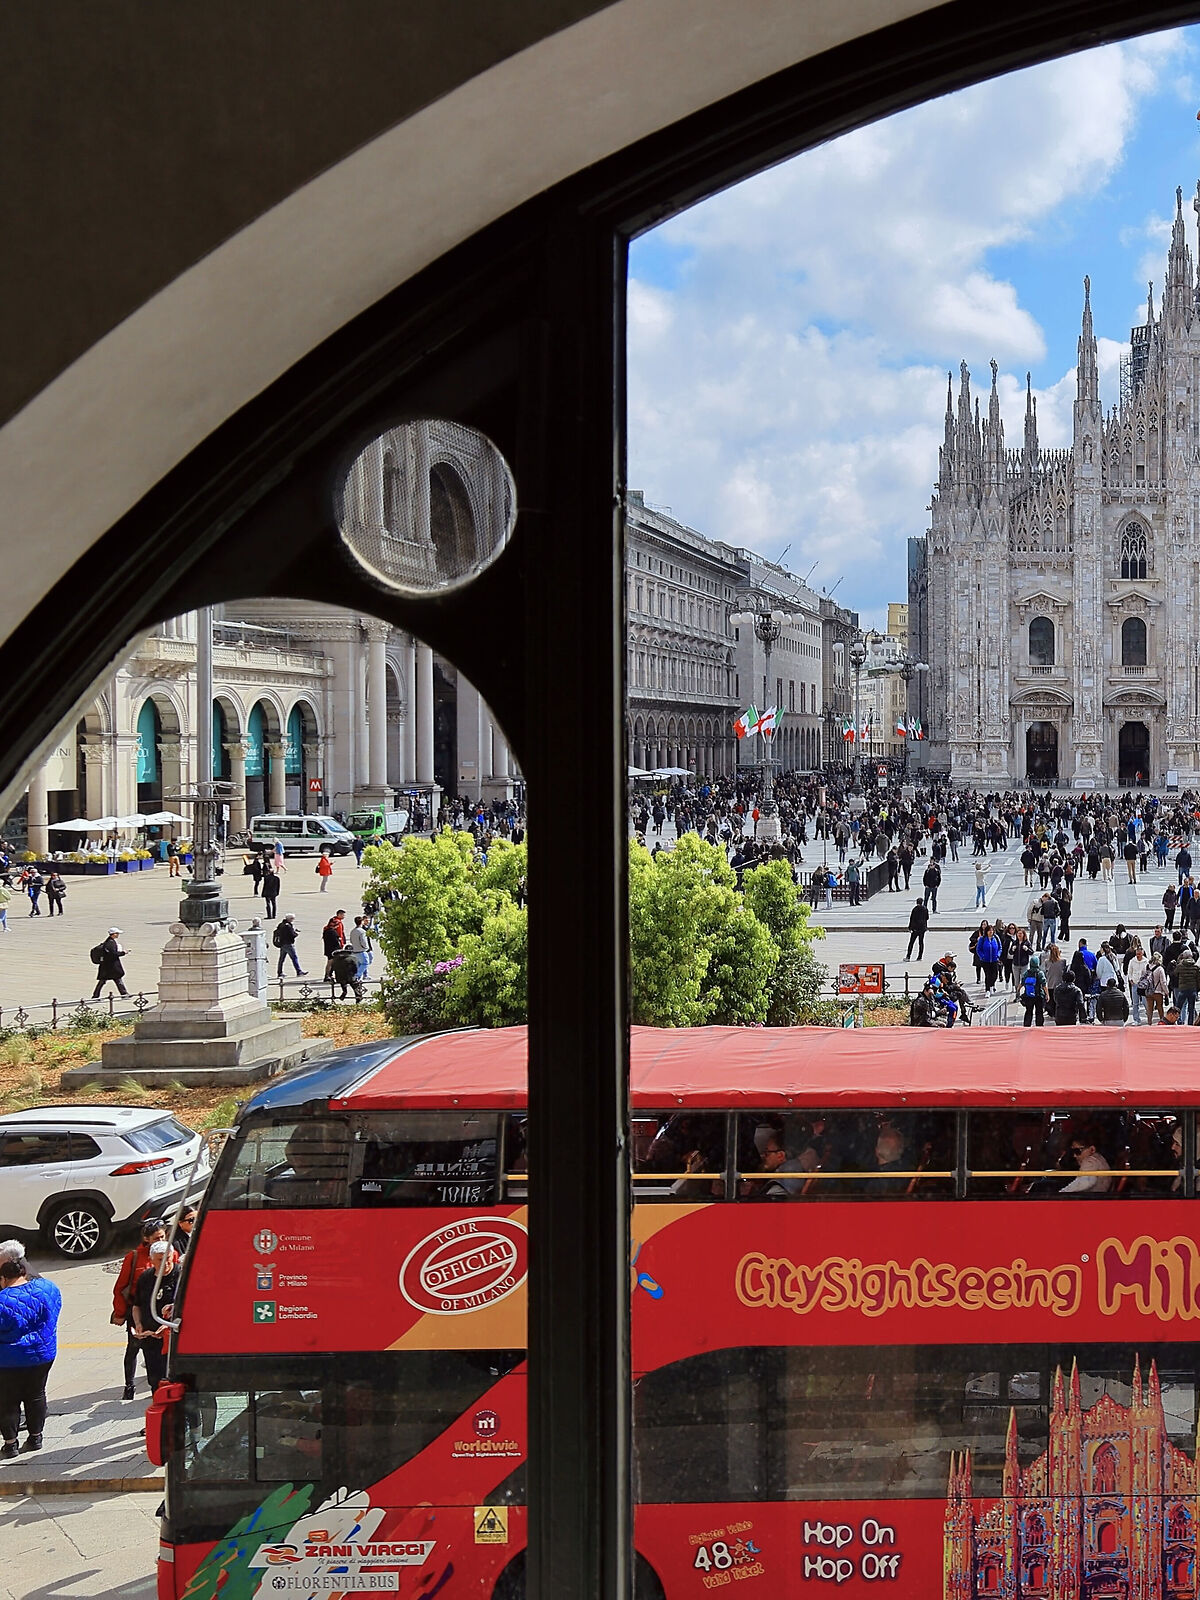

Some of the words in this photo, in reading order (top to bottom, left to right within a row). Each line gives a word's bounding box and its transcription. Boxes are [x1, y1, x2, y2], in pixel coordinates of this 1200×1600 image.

[434, 1222, 478, 1244] TOUR
[426, 1244, 513, 1286] OFFICIAL
[441, 1300, 460, 1310] OF
[465, 1276, 516, 1308] MILANO
[735, 1252, 1082, 1317] CitySightseeing
[279, 1305, 308, 1313] Regione
[454, 1440, 518, 1451] Worldwide
[803, 1521, 853, 1548] Hop
[861, 1519, 894, 1545] On
[305, 1545, 352, 1557] ZANI
[356, 1544, 425, 1556] VIAGGI
[694, 1541, 733, 1572] 48
[703, 1571, 731, 1589] Valid
[731, 1562, 765, 1580] Ticket
[803, 1555, 853, 1582] Hop
[861, 1553, 901, 1579] Off
[288, 1575, 366, 1589] FLORENTIA
[370, 1575, 394, 1588] BUS
